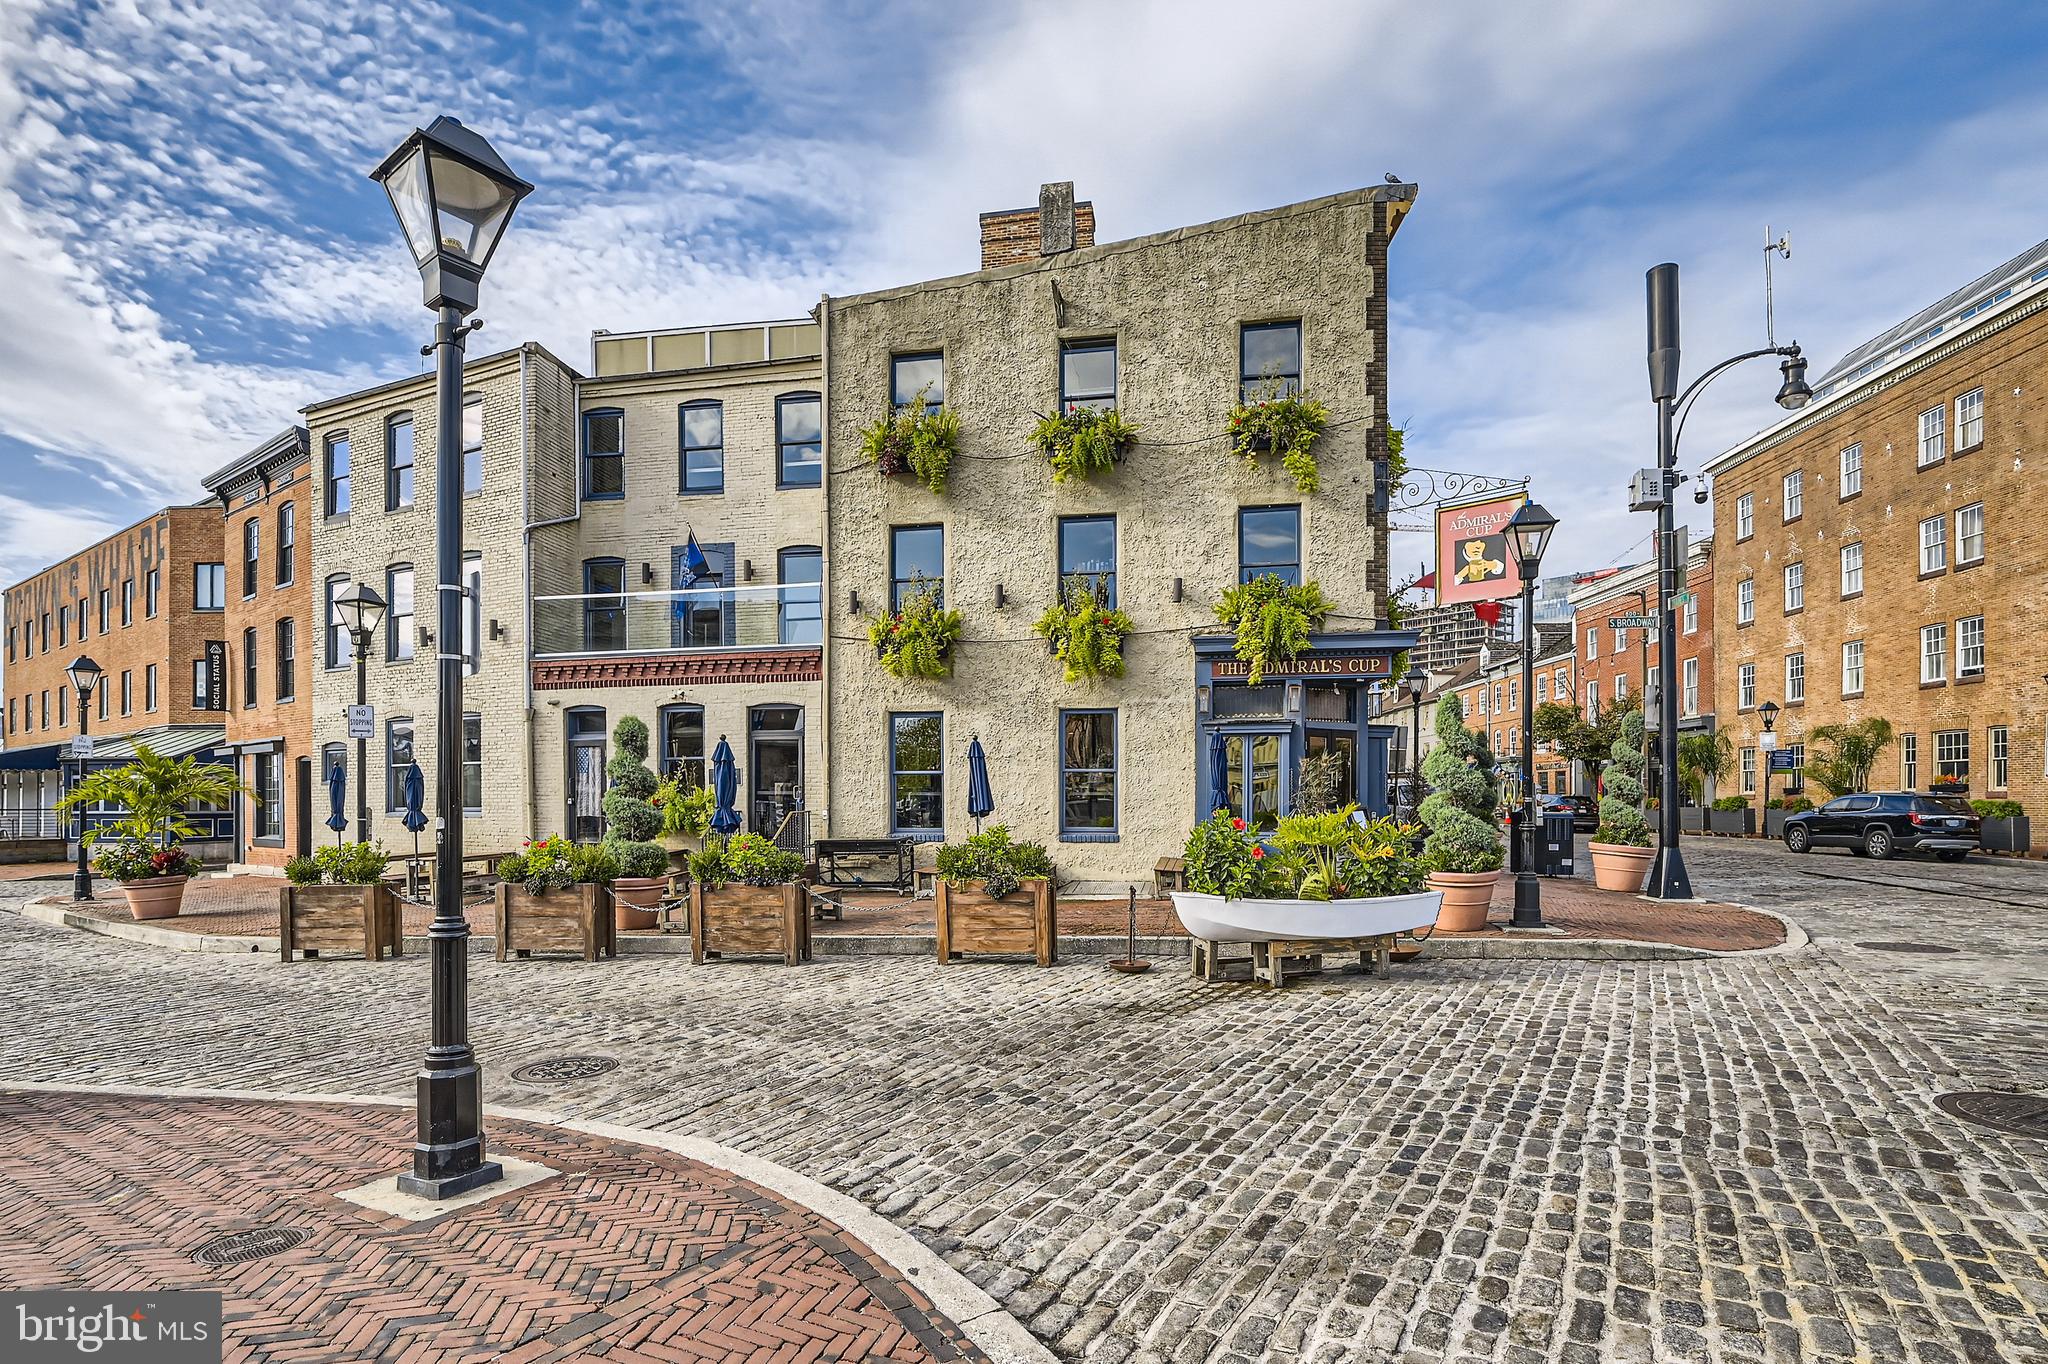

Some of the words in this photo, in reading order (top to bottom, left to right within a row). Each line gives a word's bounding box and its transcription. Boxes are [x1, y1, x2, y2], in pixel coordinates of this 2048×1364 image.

[1449, 511, 1512, 531] ADMIRAL'S
[1466, 525, 1493, 538] CUP
[87, 517, 168, 616] WHARF
[1217, 662, 1248, 675] THE
[1348, 659, 1381, 672] CUP
[356, 709, 366, 717] NO
